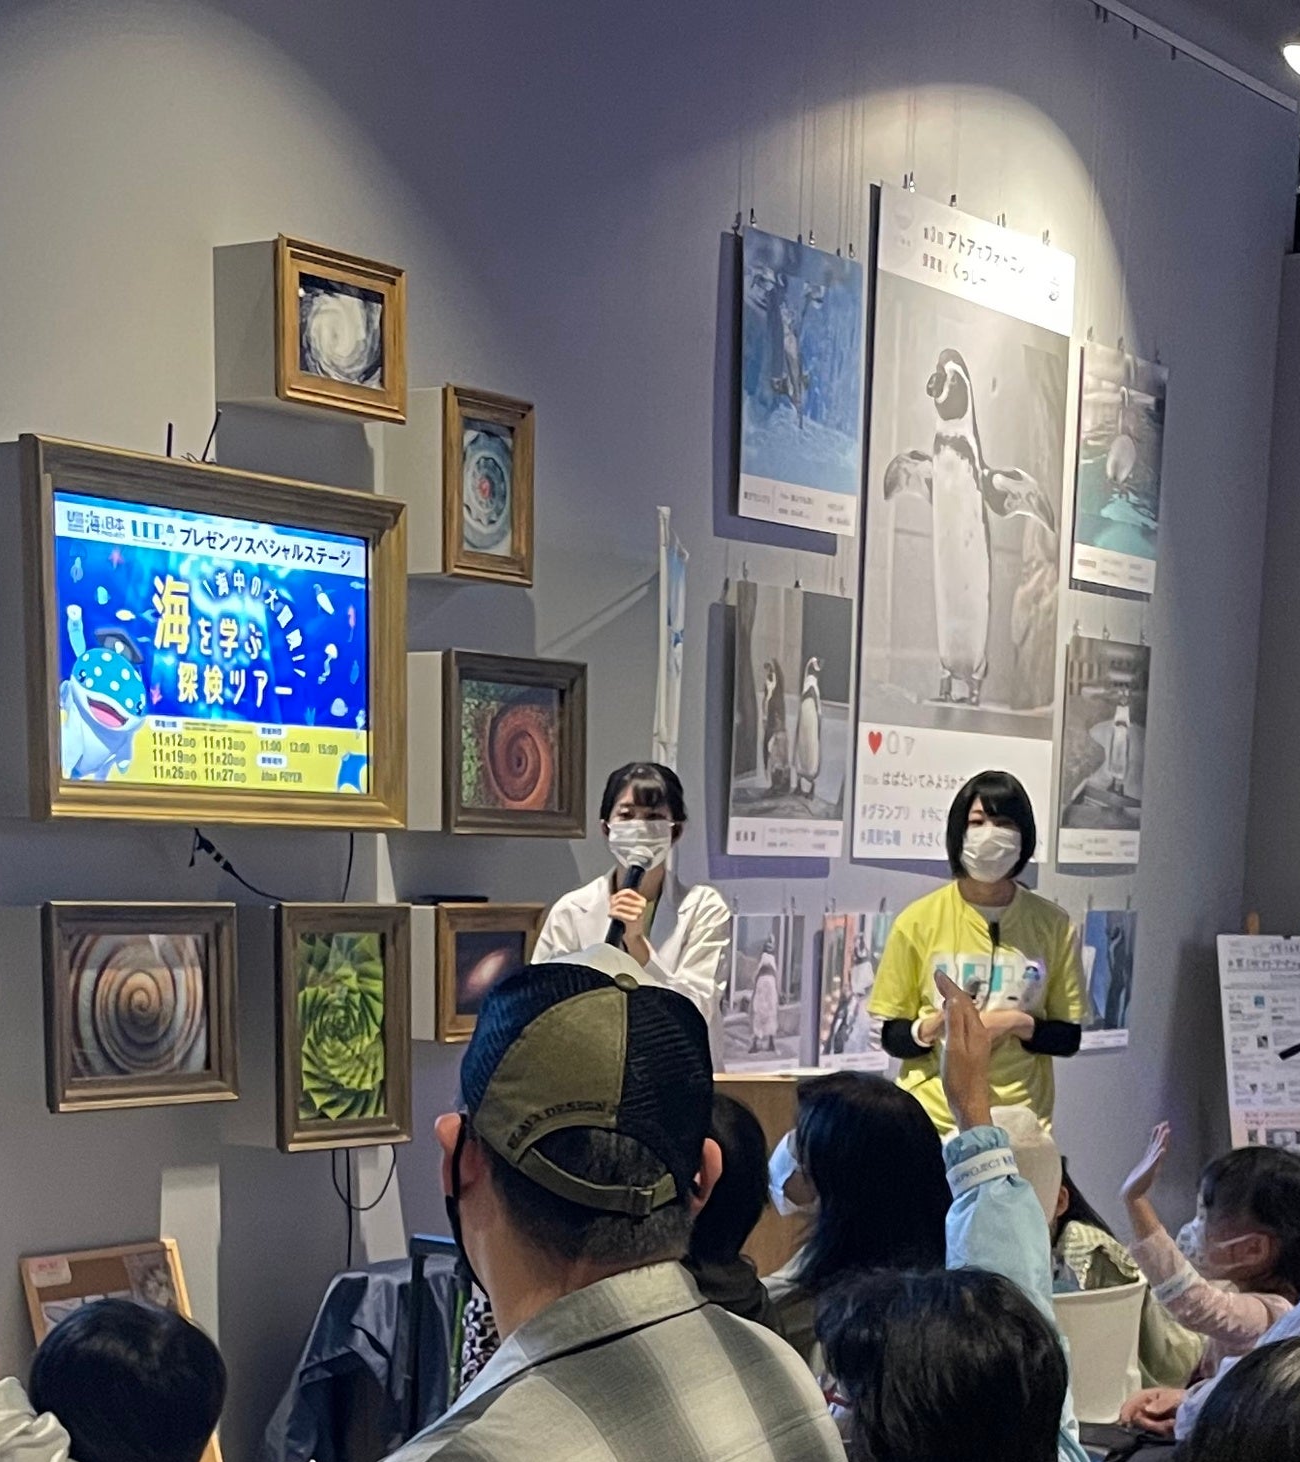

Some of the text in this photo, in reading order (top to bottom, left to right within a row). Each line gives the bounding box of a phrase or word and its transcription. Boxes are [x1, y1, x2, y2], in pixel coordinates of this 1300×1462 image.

[180, 527, 351, 568] プレゼンツスペシャルステージ
[152, 574, 263, 660] 海を学ぶ
[178, 661, 293, 708] 探検ツアー
